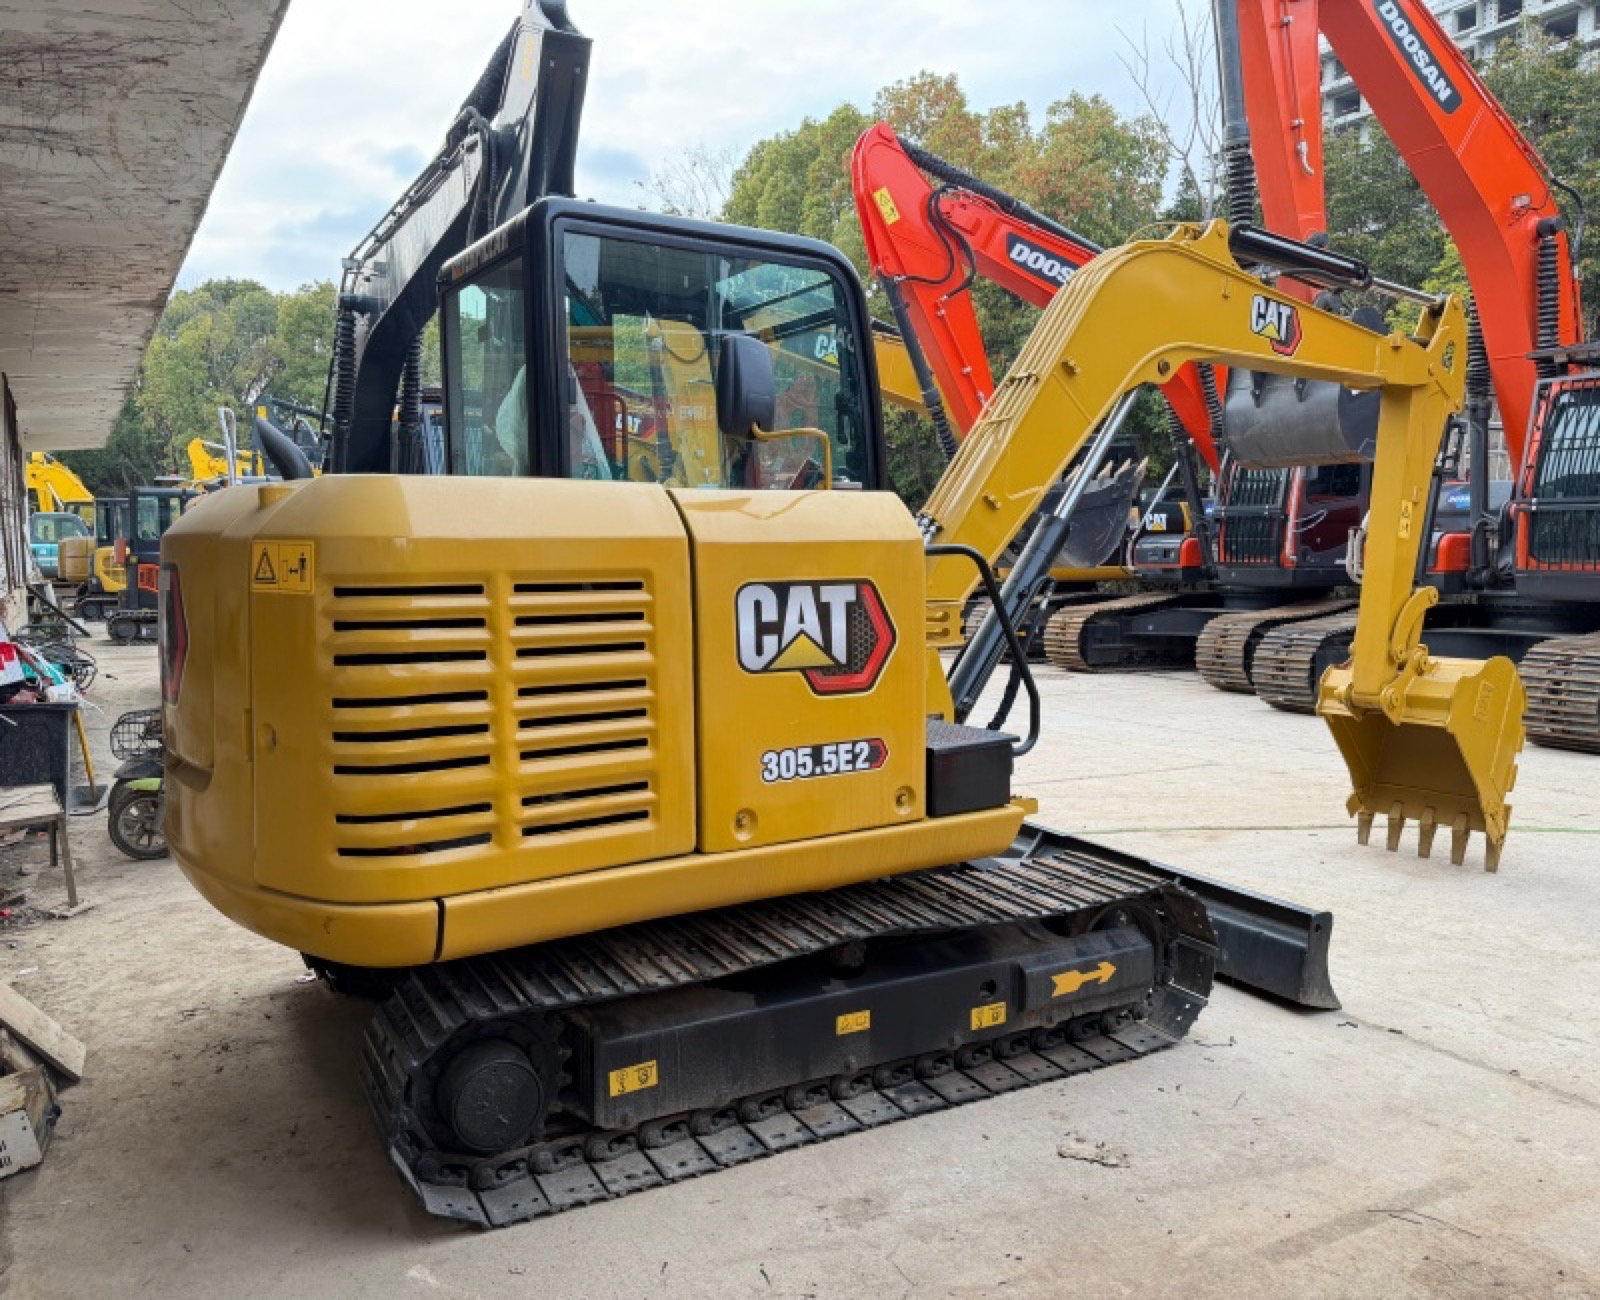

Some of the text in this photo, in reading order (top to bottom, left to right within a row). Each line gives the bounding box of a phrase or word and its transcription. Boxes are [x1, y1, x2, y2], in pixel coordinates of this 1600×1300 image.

[1379, 0, 1452, 102] DOOSAN
[1251, 295, 1291, 341] CAT
[1145, 513, 1167, 531] CAT
[737, 583, 857, 671] CAT
[763, 741, 870, 781] 305.5E2
